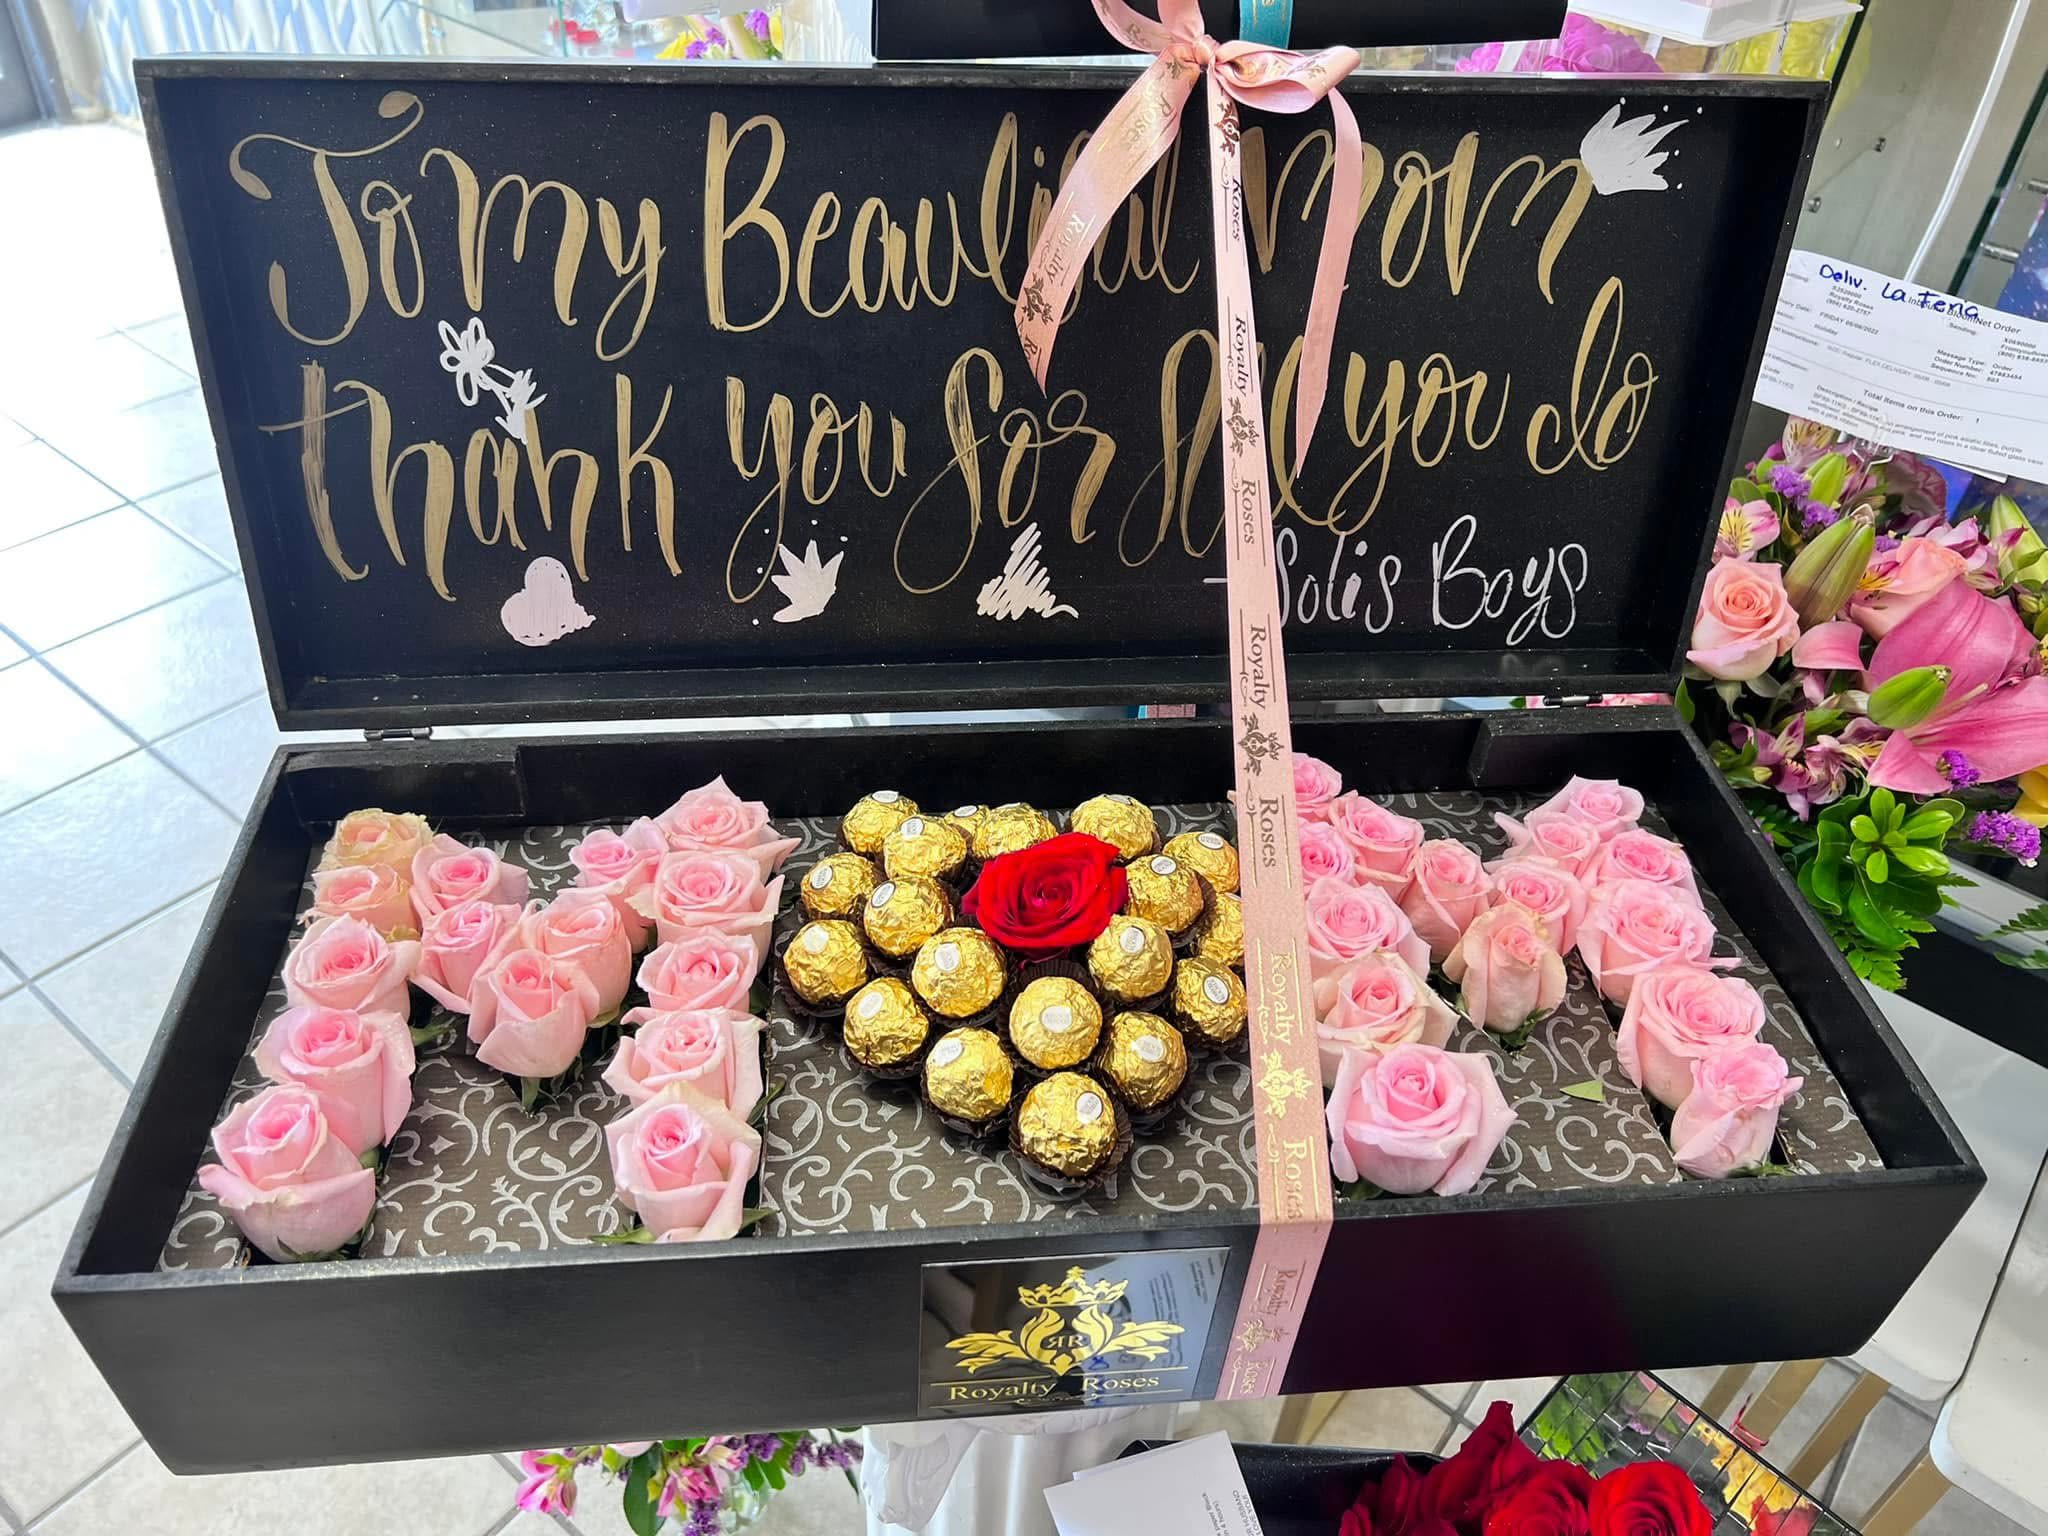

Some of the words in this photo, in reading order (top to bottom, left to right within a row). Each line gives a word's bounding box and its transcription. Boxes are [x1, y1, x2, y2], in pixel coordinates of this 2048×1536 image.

[229, 90, 425, 346] To
[1231, 176, 1243, 242] Roses
[1235, 315, 1248, 398] Royalty
[1993, 322, 2021, 335] Order
[725, 374, 909, 604] you
[893, 347, 1118, 595] for
[1328, 350, 1512, 536] you
[1526, 276, 1660, 475] do
[1863, 389, 1883, 401] Total
[1885, 395, 1905, 409] Items
[1906, 402, 1918, 412] on
[1919, 404, 1936, 415] this
[1937, 409, 1964, 421] Order:
[1240, 477, 1256, 545] Roses
[1432, 514, 1588, 647] Boys
[1247, 624, 1269, 711] Royalty
[1257, 795, 1279, 869] Roses
[1268, 951, 1293, 1046] Royalty
[1282, 1139, 1307, 1221] Roses
[949, 1380, 1058, 1401] Royalty
[1082, 1373, 1160, 1392] Roses
